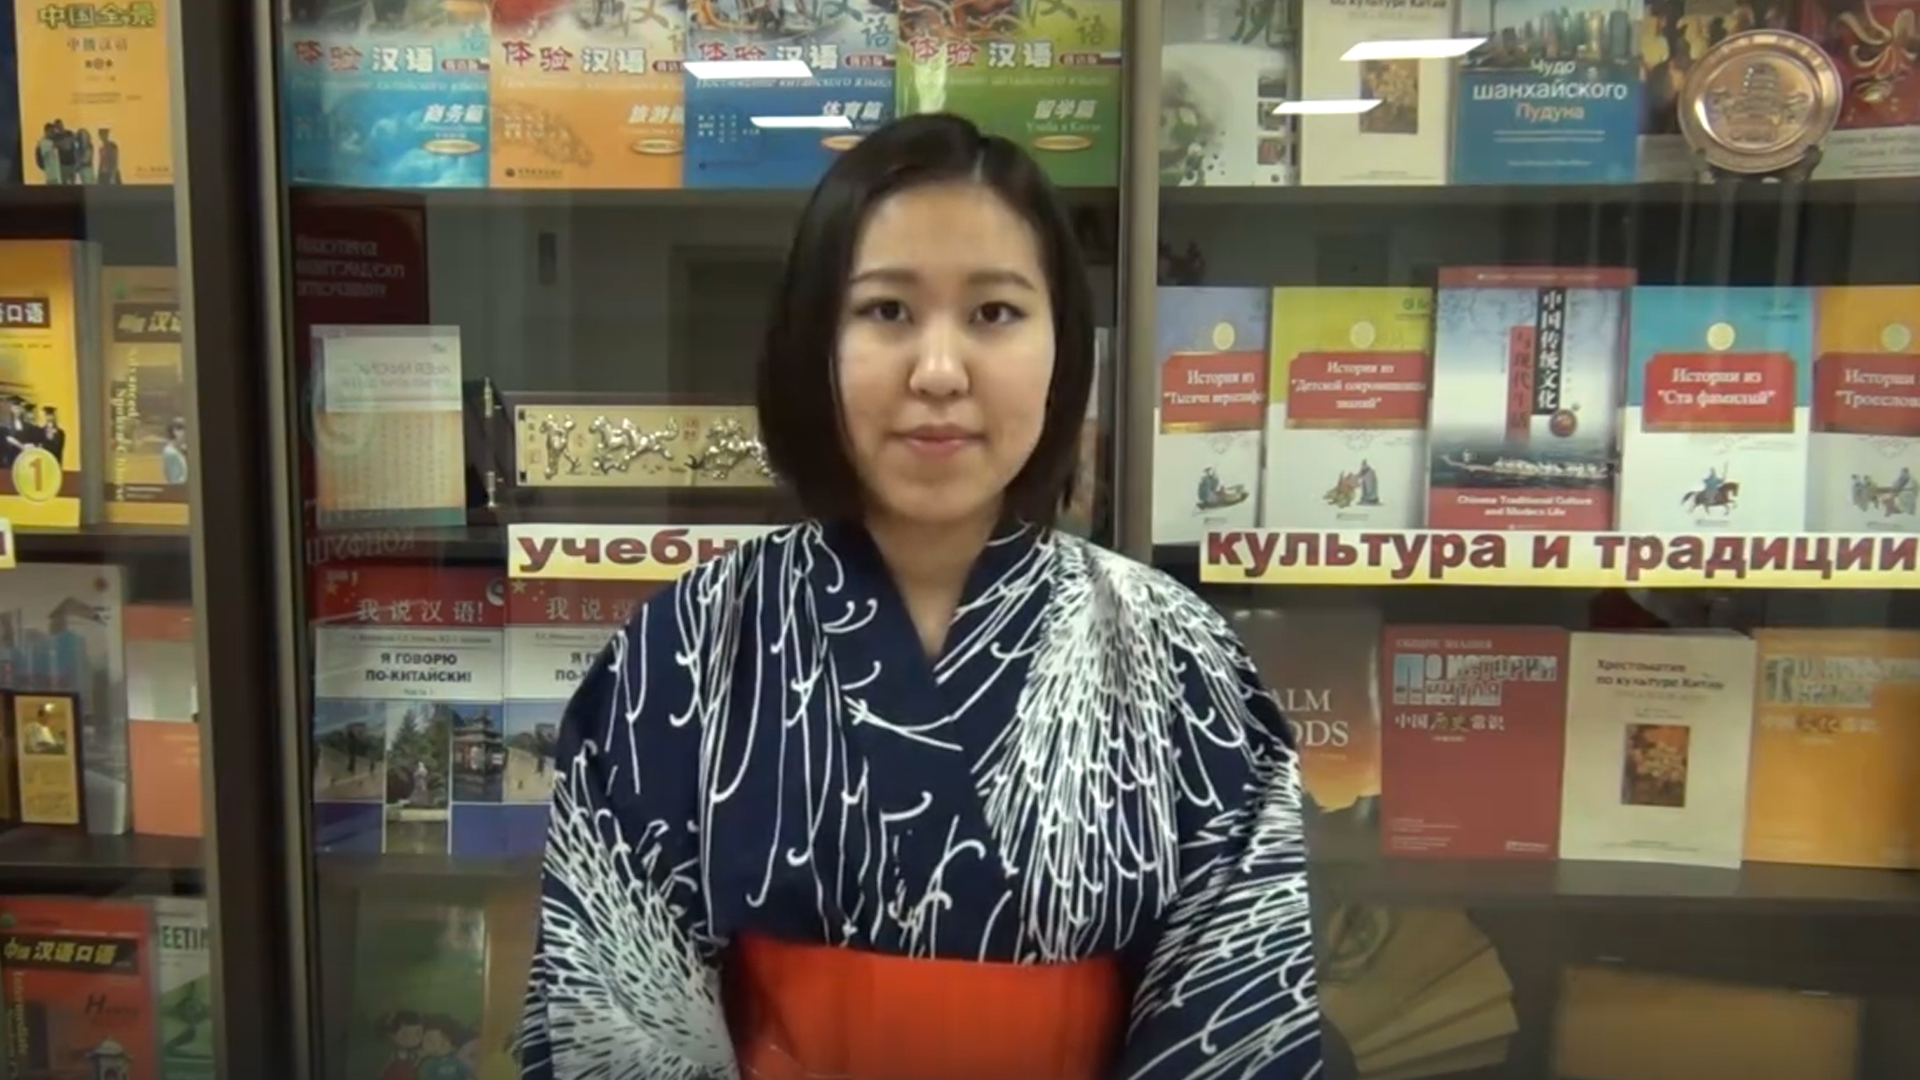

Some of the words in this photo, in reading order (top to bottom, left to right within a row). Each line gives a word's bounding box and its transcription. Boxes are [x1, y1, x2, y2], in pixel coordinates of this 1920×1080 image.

[38, 1, 156, 29] 中国全景
[294, 39, 435, 74] 体验汉语
[502, 39, 647, 74] 体验汉语
[908, 37, 1054, 69] 体验汉语
[1531, 58, 1576, 77] Чудо
[1472, 78, 1628, 100] шанхайского
[1516, 101, 1585, 122] Пудуна
[1538, 290, 1563, 410] 中国传统文化
[1187, 369, 1240, 387] Истории
[1672, 367, 1740, 387] Истории
[1744, 371, 1762, 383] из
[1845, 368, 1915, 389] Истории
[30, 457, 42, 492] 1
[1207, 532, 1506, 579] культура
[1533, 533, 1569, 570] и
[1594, 533, 1917, 581] традиции
[357, 598, 484, 623] 我说汉语!
[380, 653, 390, 665] Я
[395, 653, 457, 665] ГОВОРЮ
[365, 668, 472, 683] ПО-КИТАЙСКИ!
[1394, 711, 1506, 731] 中国历史常识
